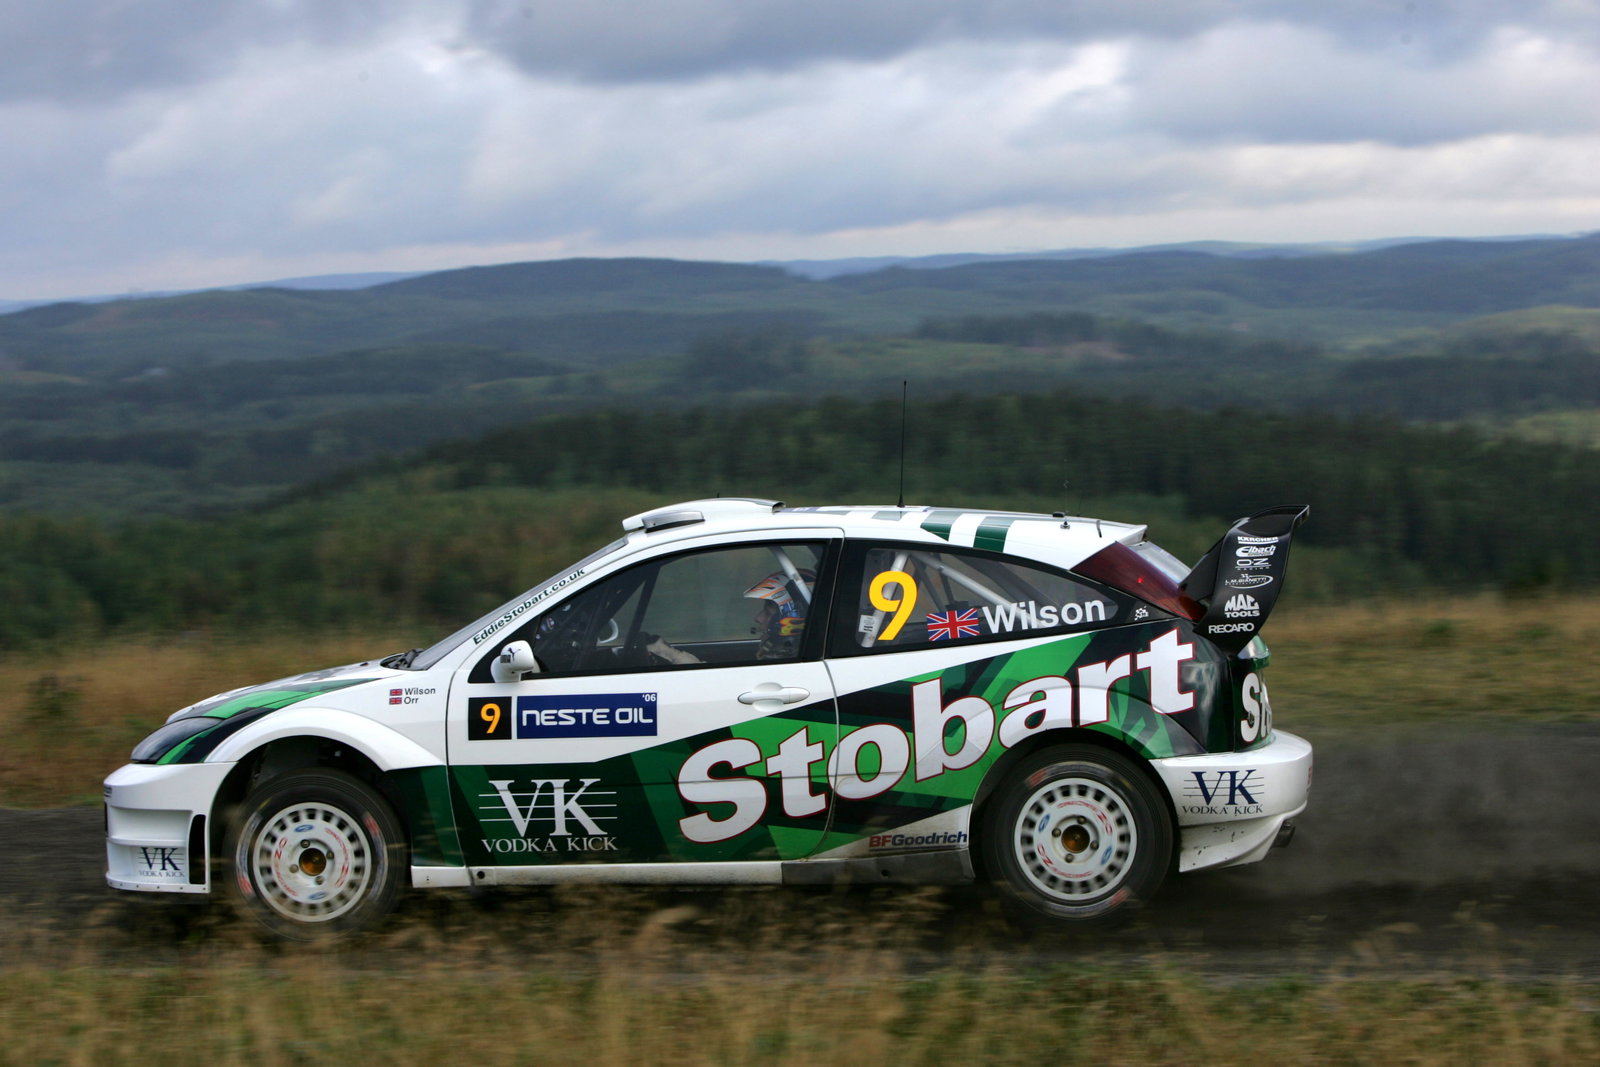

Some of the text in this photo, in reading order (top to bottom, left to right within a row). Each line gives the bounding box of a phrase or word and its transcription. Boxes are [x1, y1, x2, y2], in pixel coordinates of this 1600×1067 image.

[473, 568, 585, 645] EddieStobart.co.uk
[868, 570, 917, 640] 9
[1224, 594, 1259, 610] MAC
[982, 599, 1106, 634] Wilson
[1208, 622, 1254, 633] RECARO
[404, 687, 436, 695] Wilson
[480, 703, 501, 734] 9
[522, 707, 653, 726] NESTE OIL
[677, 627, 1195, 843] Stobart
[1191, 769, 1258, 805] VK
[488, 778, 608, 837] VK
[1182, 804, 1263, 815] VODKA KICK
[481, 837, 618, 852] VODKA KICK
[869, 831, 967, 847] BFGoodrich
[141, 847, 180, 870] VK
